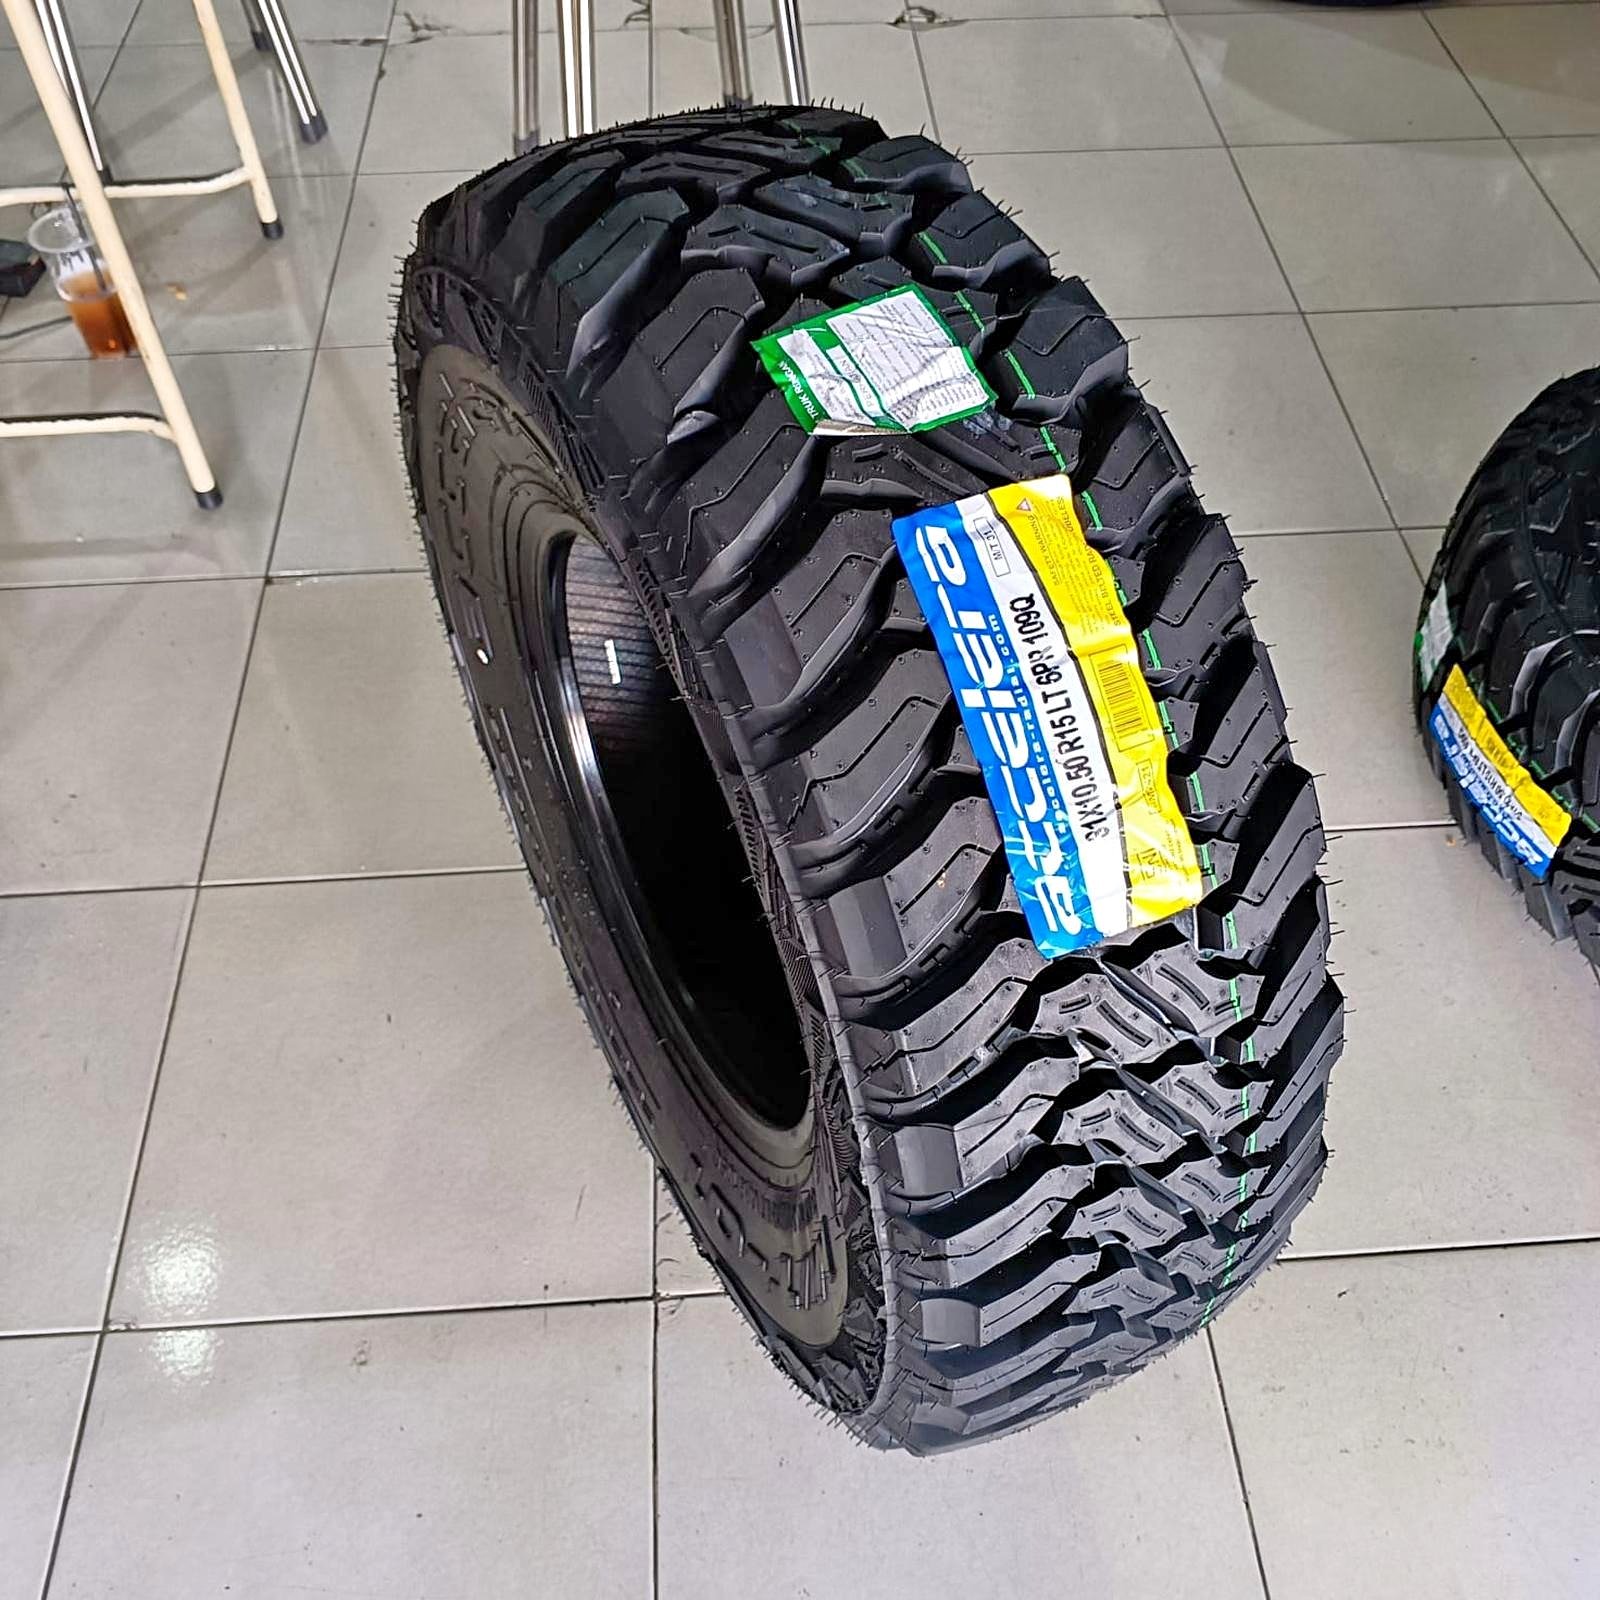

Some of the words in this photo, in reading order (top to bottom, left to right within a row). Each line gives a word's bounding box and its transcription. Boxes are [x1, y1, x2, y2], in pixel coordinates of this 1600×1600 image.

[800, 393, 819, 419] TRUK
[989, 543, 1003, 561] M/T
[1009, 593, 1049, 646] 109Q
[1027, 646, 1063, 686] 6PR
[1041, 688, 1073, 715] LT
[915, 525, 1082, 935] accelera
[1050, 716, 1085, 755] R15
